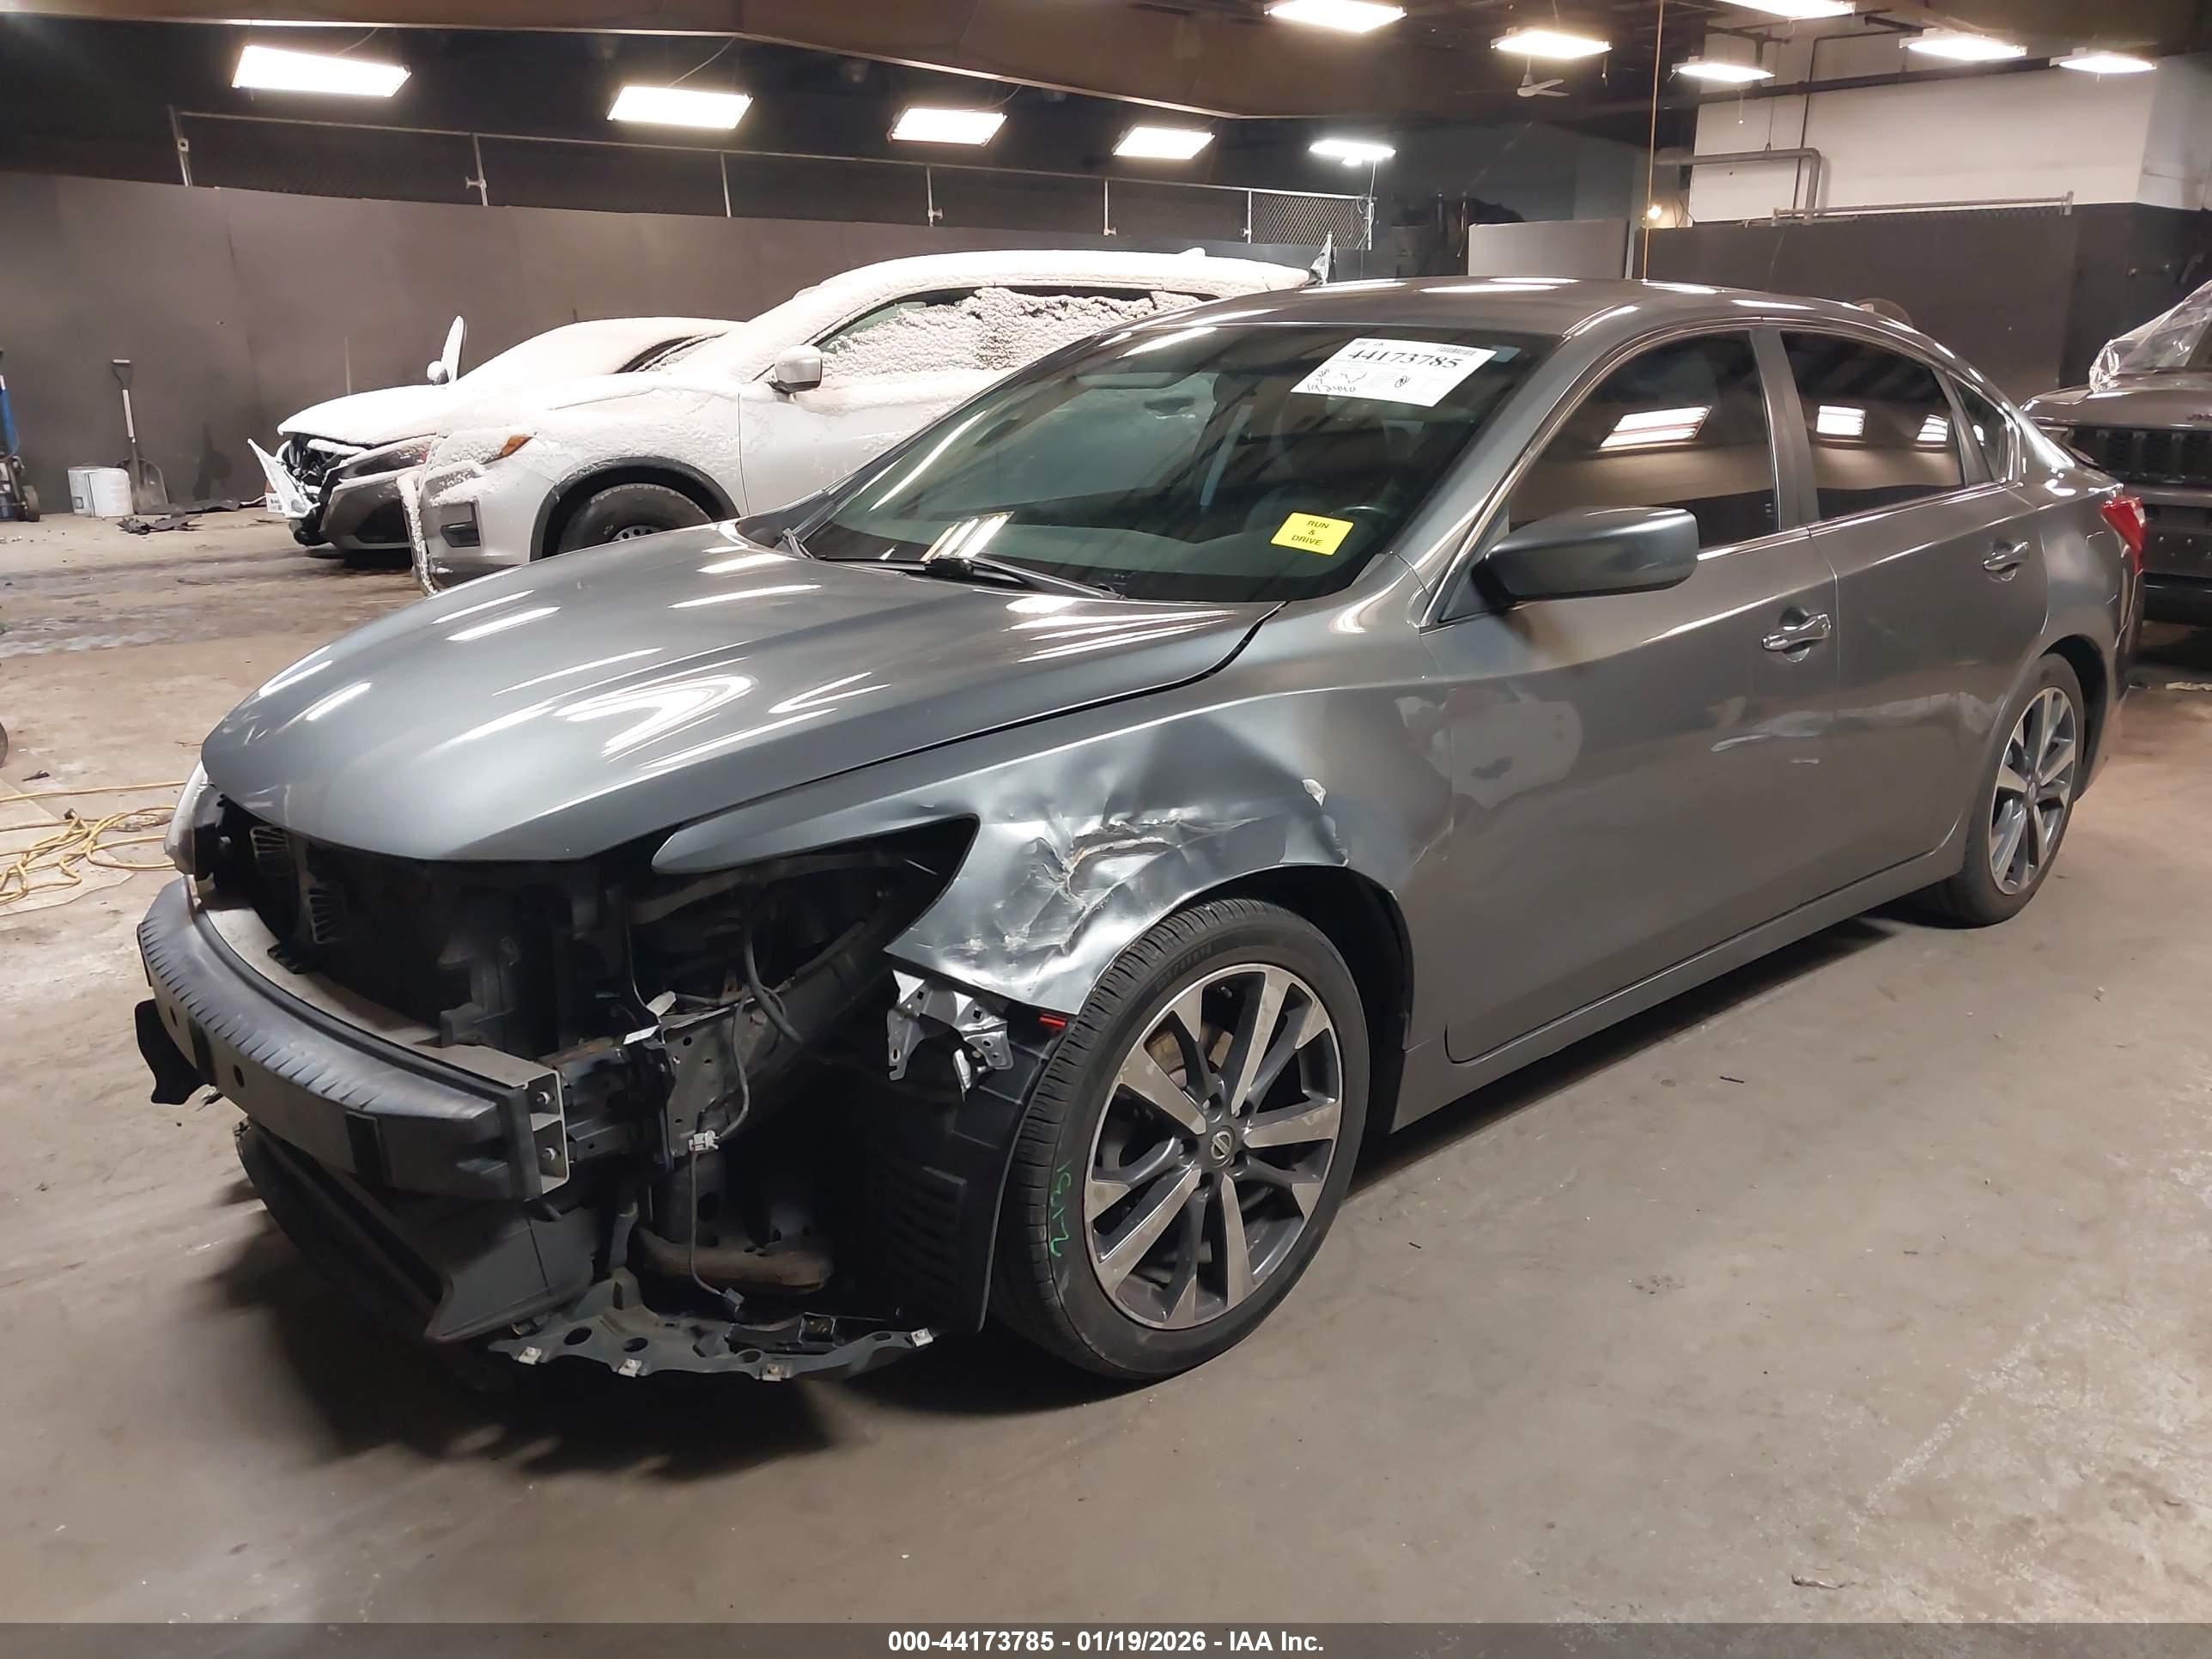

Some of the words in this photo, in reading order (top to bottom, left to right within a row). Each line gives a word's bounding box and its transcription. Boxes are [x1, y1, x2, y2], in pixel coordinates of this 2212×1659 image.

[1347, 349, 1463, 368] 44173785
[1307, 520, 1330, 529] RUN
[1291, 534, 1323, 546] DRIVE
